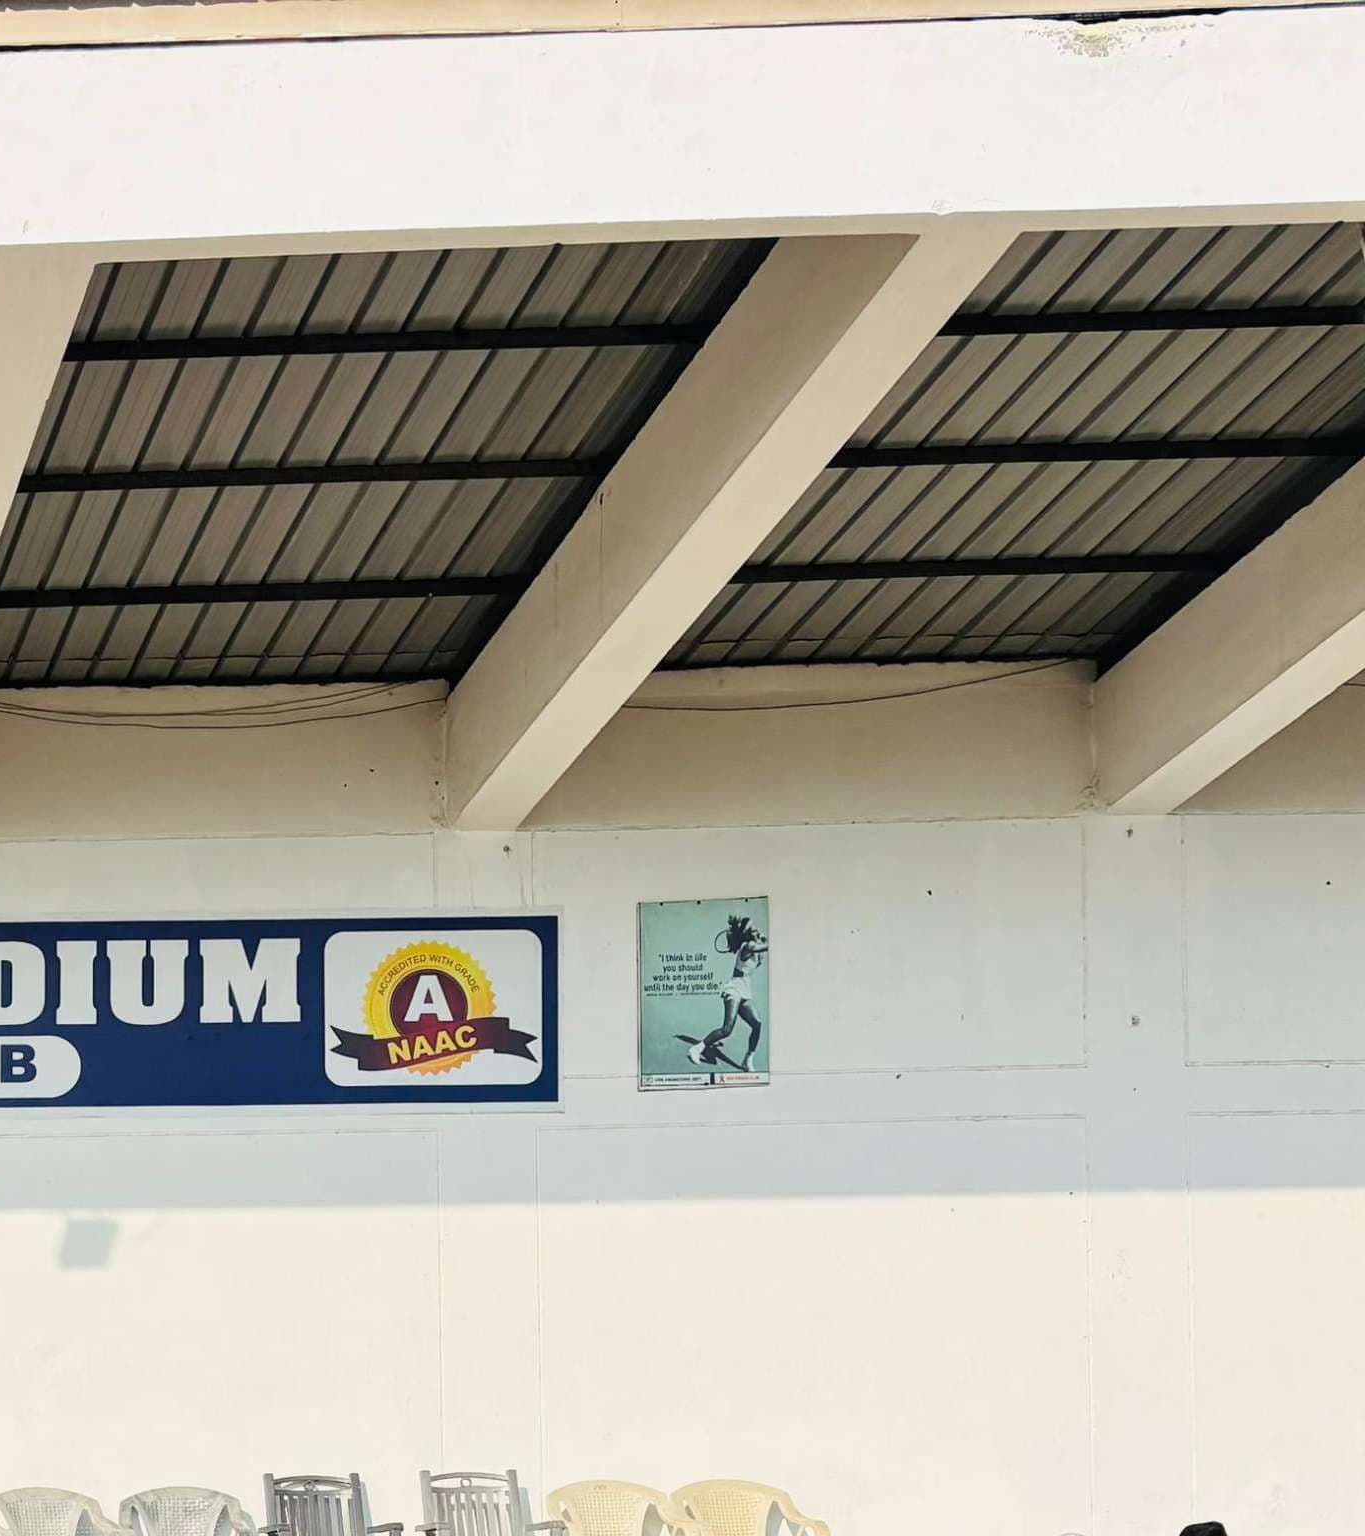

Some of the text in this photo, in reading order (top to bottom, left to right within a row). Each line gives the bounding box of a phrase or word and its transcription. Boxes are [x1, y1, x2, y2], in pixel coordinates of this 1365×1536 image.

[666, 953, 684, 962] think
[663, 965, 676, 973] you
[378, 954, 481, 996] ACCREDITED WITH GRADE
[653, 974, 670, 982] work
[684, 973, 714, 983] yourself
[644, 984, 661, 992] until
[677, 983, 689, 992] day
[691, 984, 704, 992] you
[404, 975, 454, 1022] A
[387, 1025, 477, 1064] NAAC
